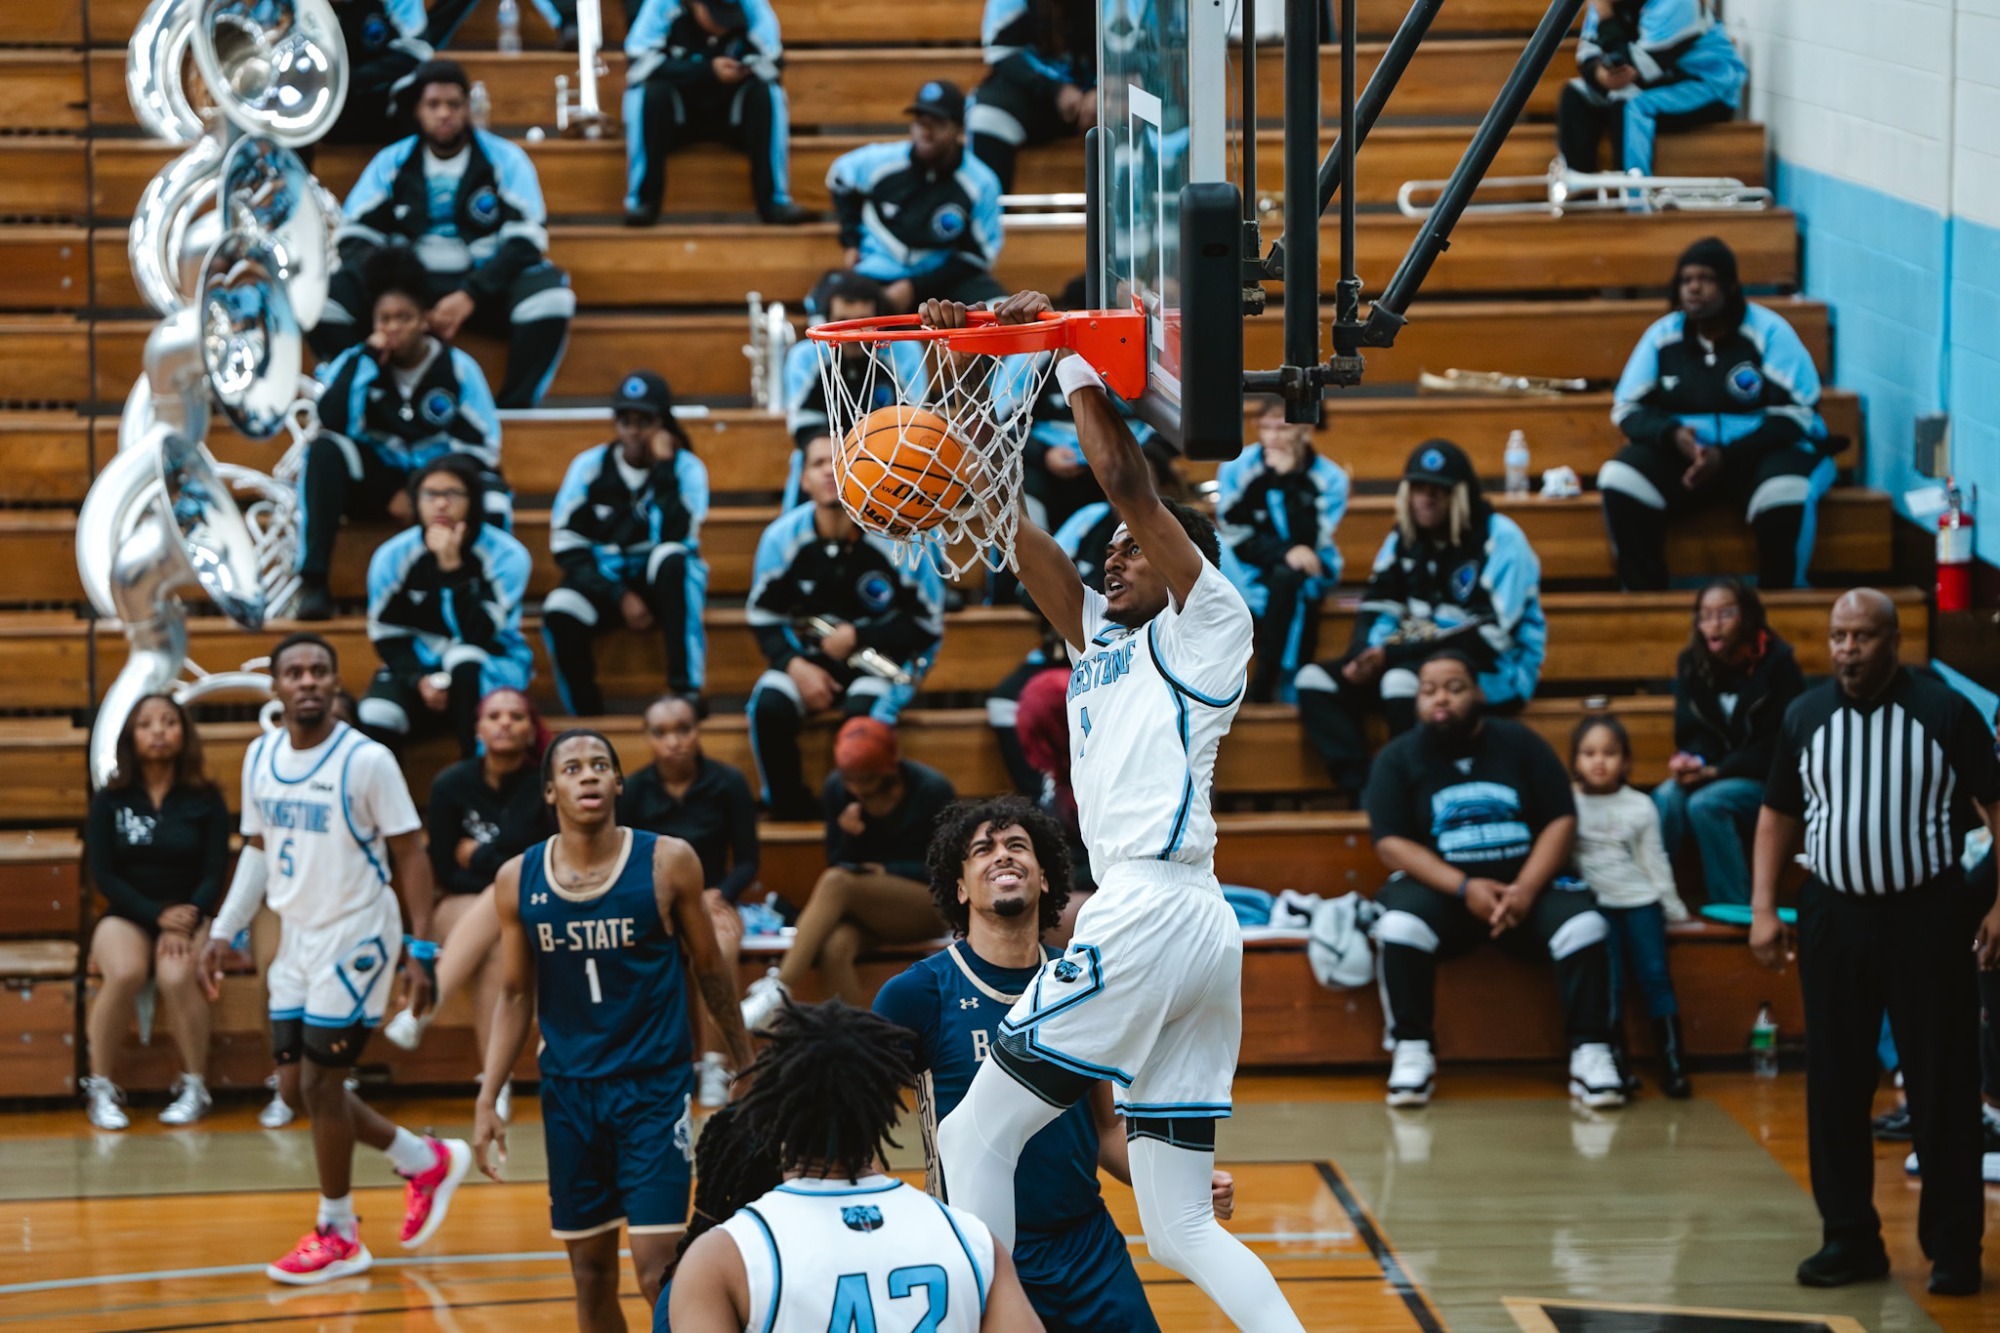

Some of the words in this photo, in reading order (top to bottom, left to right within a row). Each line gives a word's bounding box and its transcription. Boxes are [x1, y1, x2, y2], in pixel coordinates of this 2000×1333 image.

[1080, 706, 1092, 759] 1
[279, 838, 294, 877] 5
[537, 918, 635, 952] B-STATE
[585, 958, 602, 1003] 1
